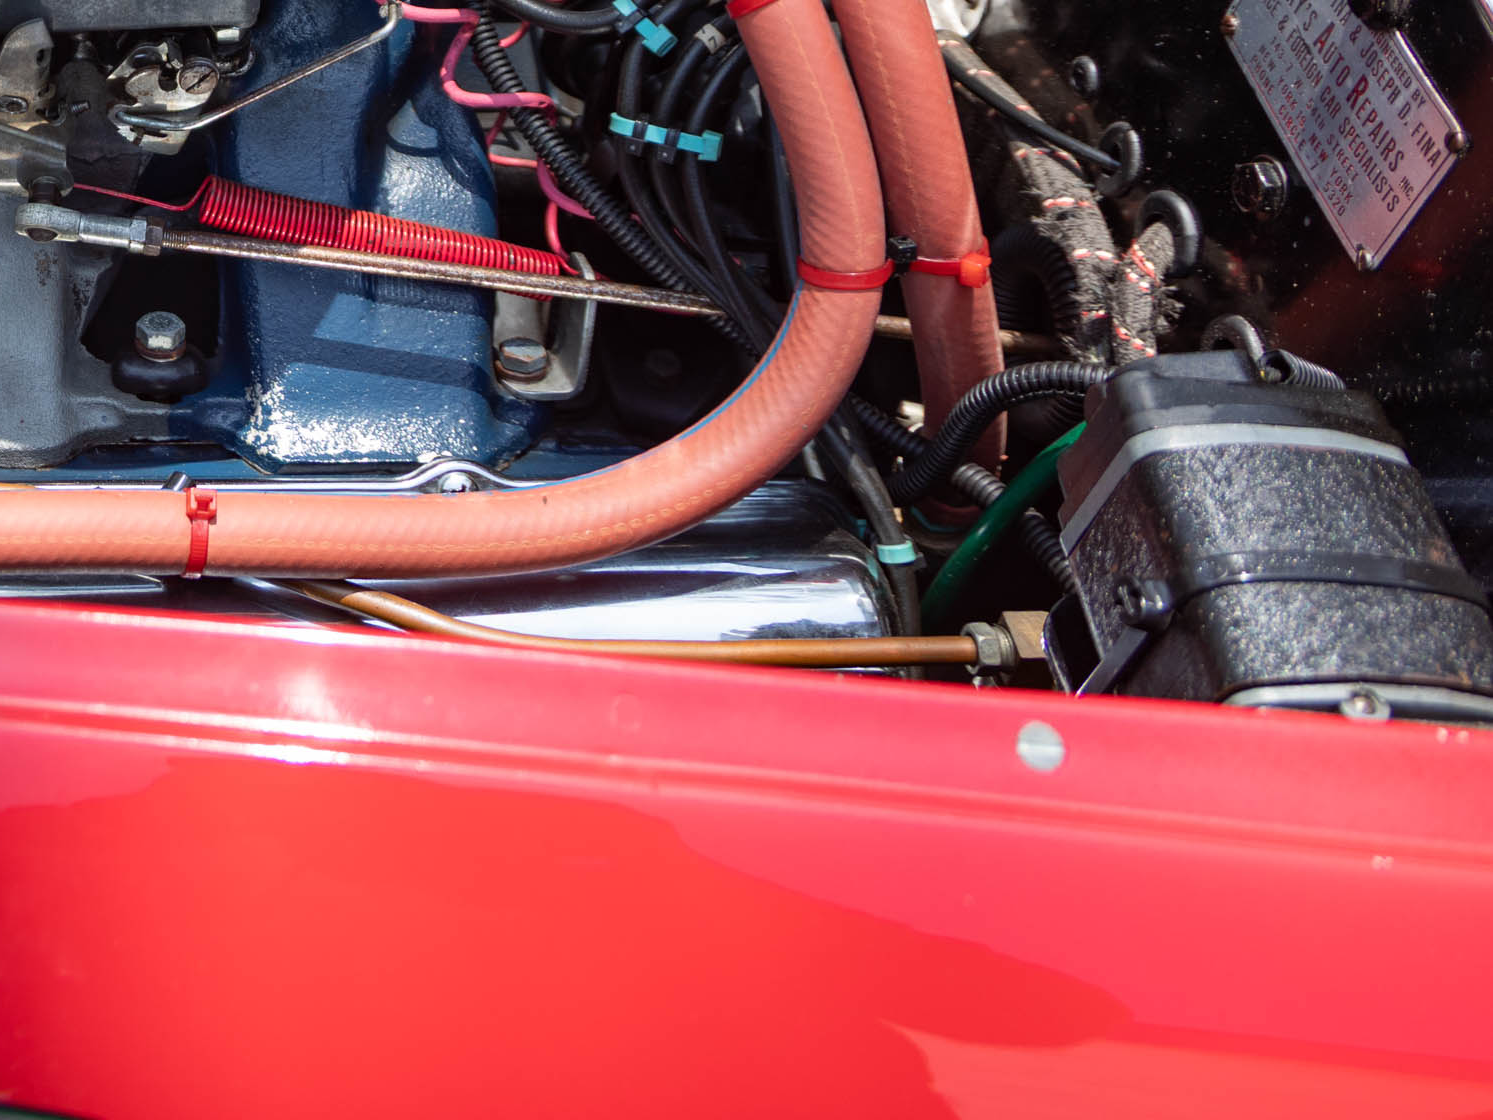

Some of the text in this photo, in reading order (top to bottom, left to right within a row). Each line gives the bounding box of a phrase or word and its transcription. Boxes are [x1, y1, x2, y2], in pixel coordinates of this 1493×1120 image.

[1249, 52, 1276, 96] PHONE
[1276, 103, 1307, 151] CIRCLE
[1257, 43, 1275, 72] NEW
[1275, 75, 1298, 111] YORK
[1308, 132, 1328, 164] NEW
[1329, 166, 1353, 205] YORK
[1276, 11, 1290, 33] &
[1285, 25, 1324, 89] FOREIGN
[1319, 84, 1342, 120] CAR
[1337, 115, 1400, 214] SPECIALISTS
[1311, 16, 1351, 89] AUTO
[1345, 72, 1405, 174] REPAIRS
[1398, 174, 1415, 201] INC.
[1326, 132, 1358, 183] STREET
[1348, 21, 1363, 45] &
[1359, 37, 1402, 105] JOSEPH
[1397, 100, 1415, 127] D.
[1410, 120, 1442, 168] FINA
[1411, 88, 1425, 110] BY
